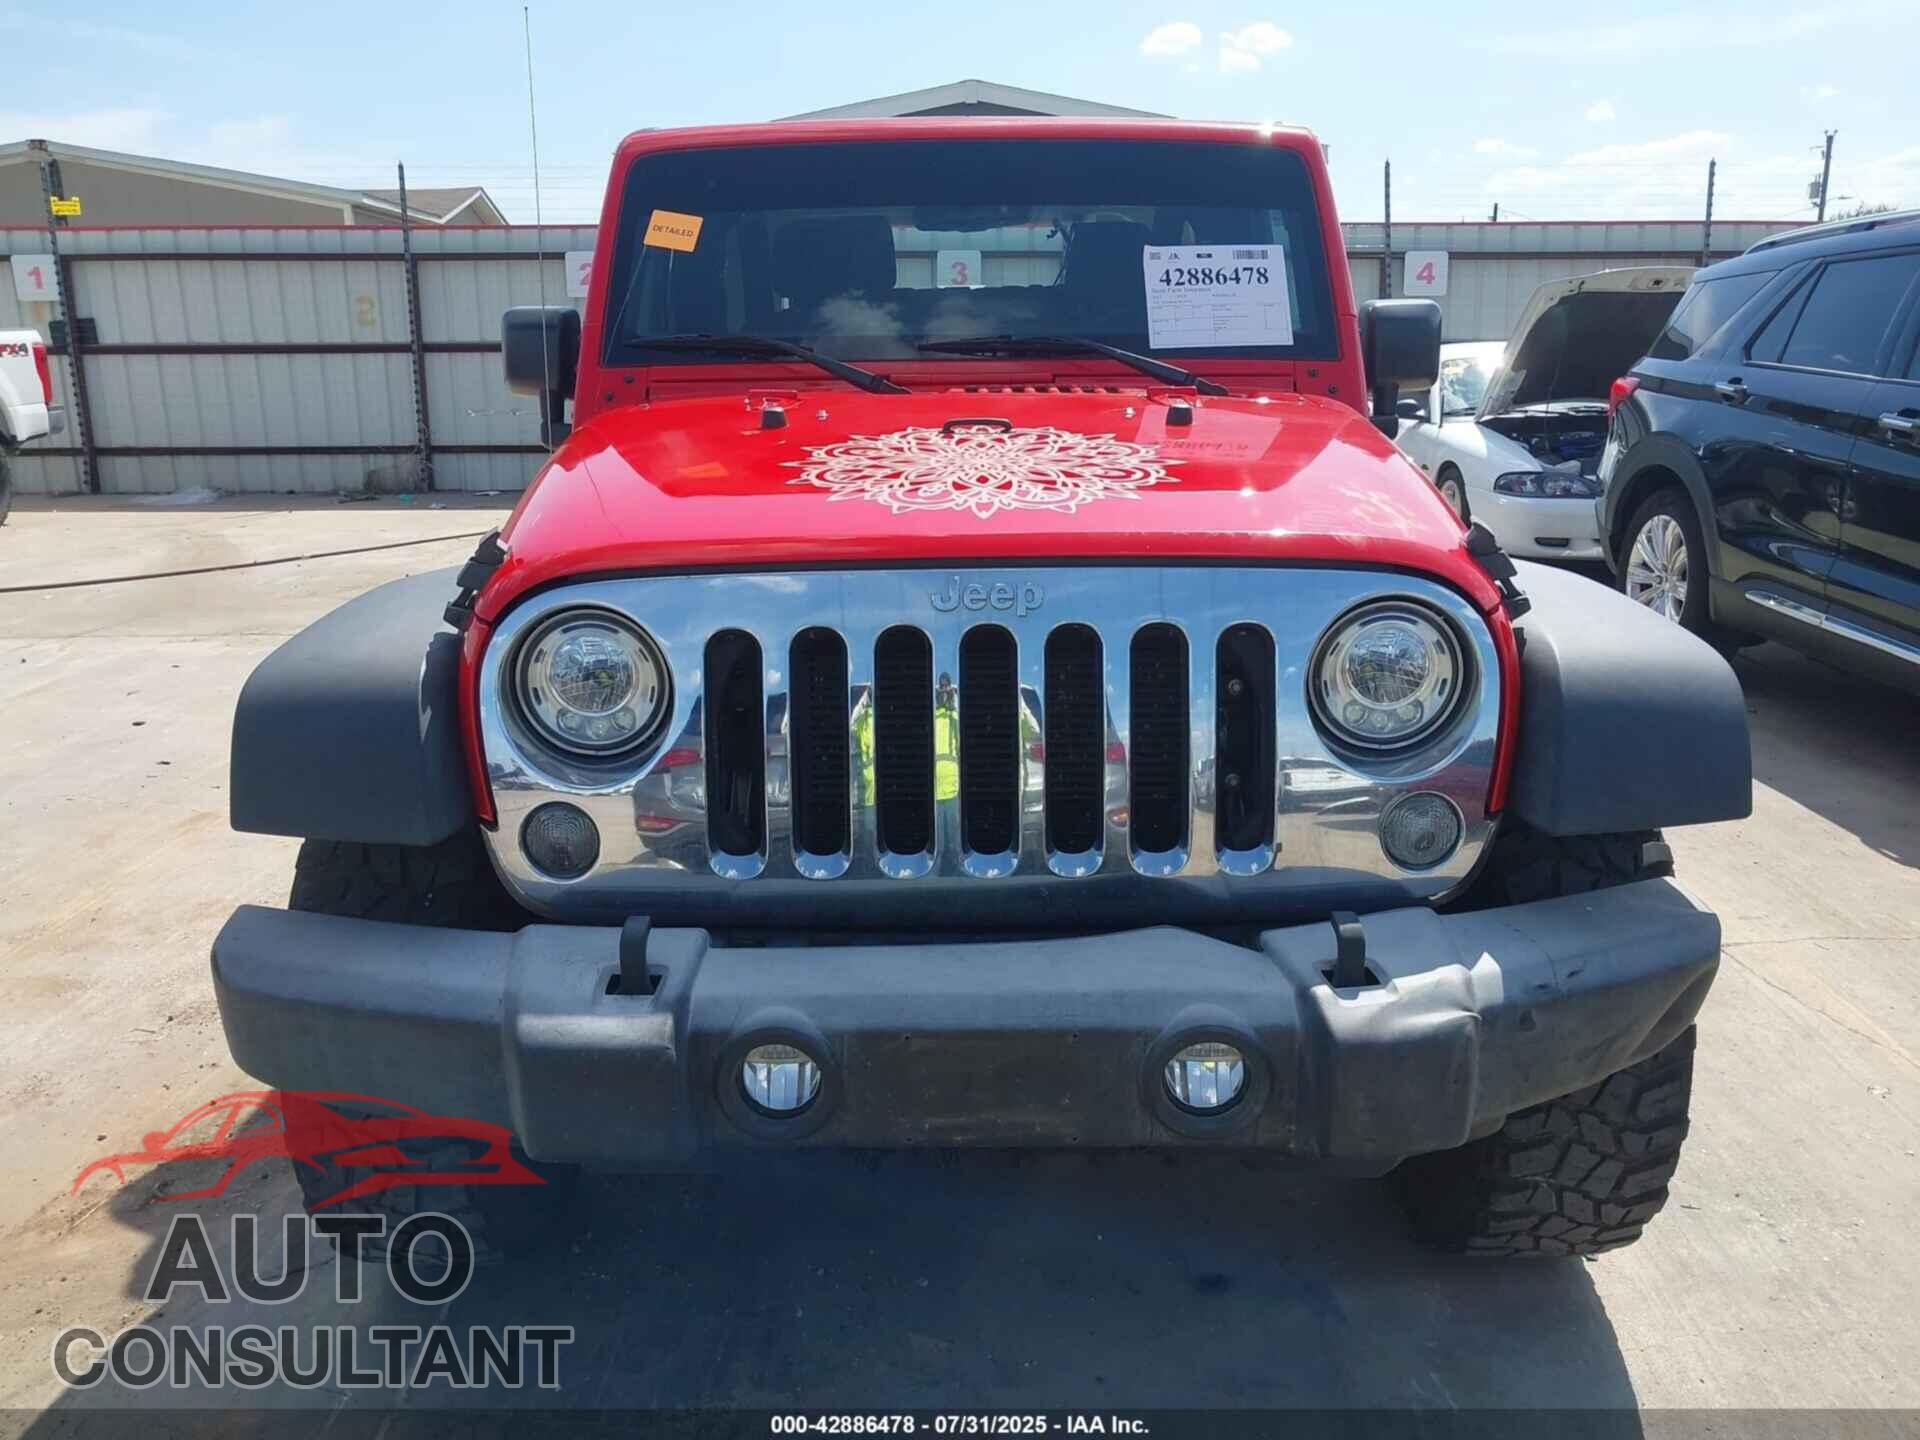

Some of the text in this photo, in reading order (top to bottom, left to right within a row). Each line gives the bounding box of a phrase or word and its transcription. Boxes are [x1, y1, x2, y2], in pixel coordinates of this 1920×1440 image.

[652, 224, 694, 238] DETAILED
[28, 266, 44, 289] 1
[951, 261, 968, 285] 3
[1160, 266, 1269, 286] 42886478
[1416, 262, 1436, 285] 4
[930, 575, 1043, 617] Jeep
